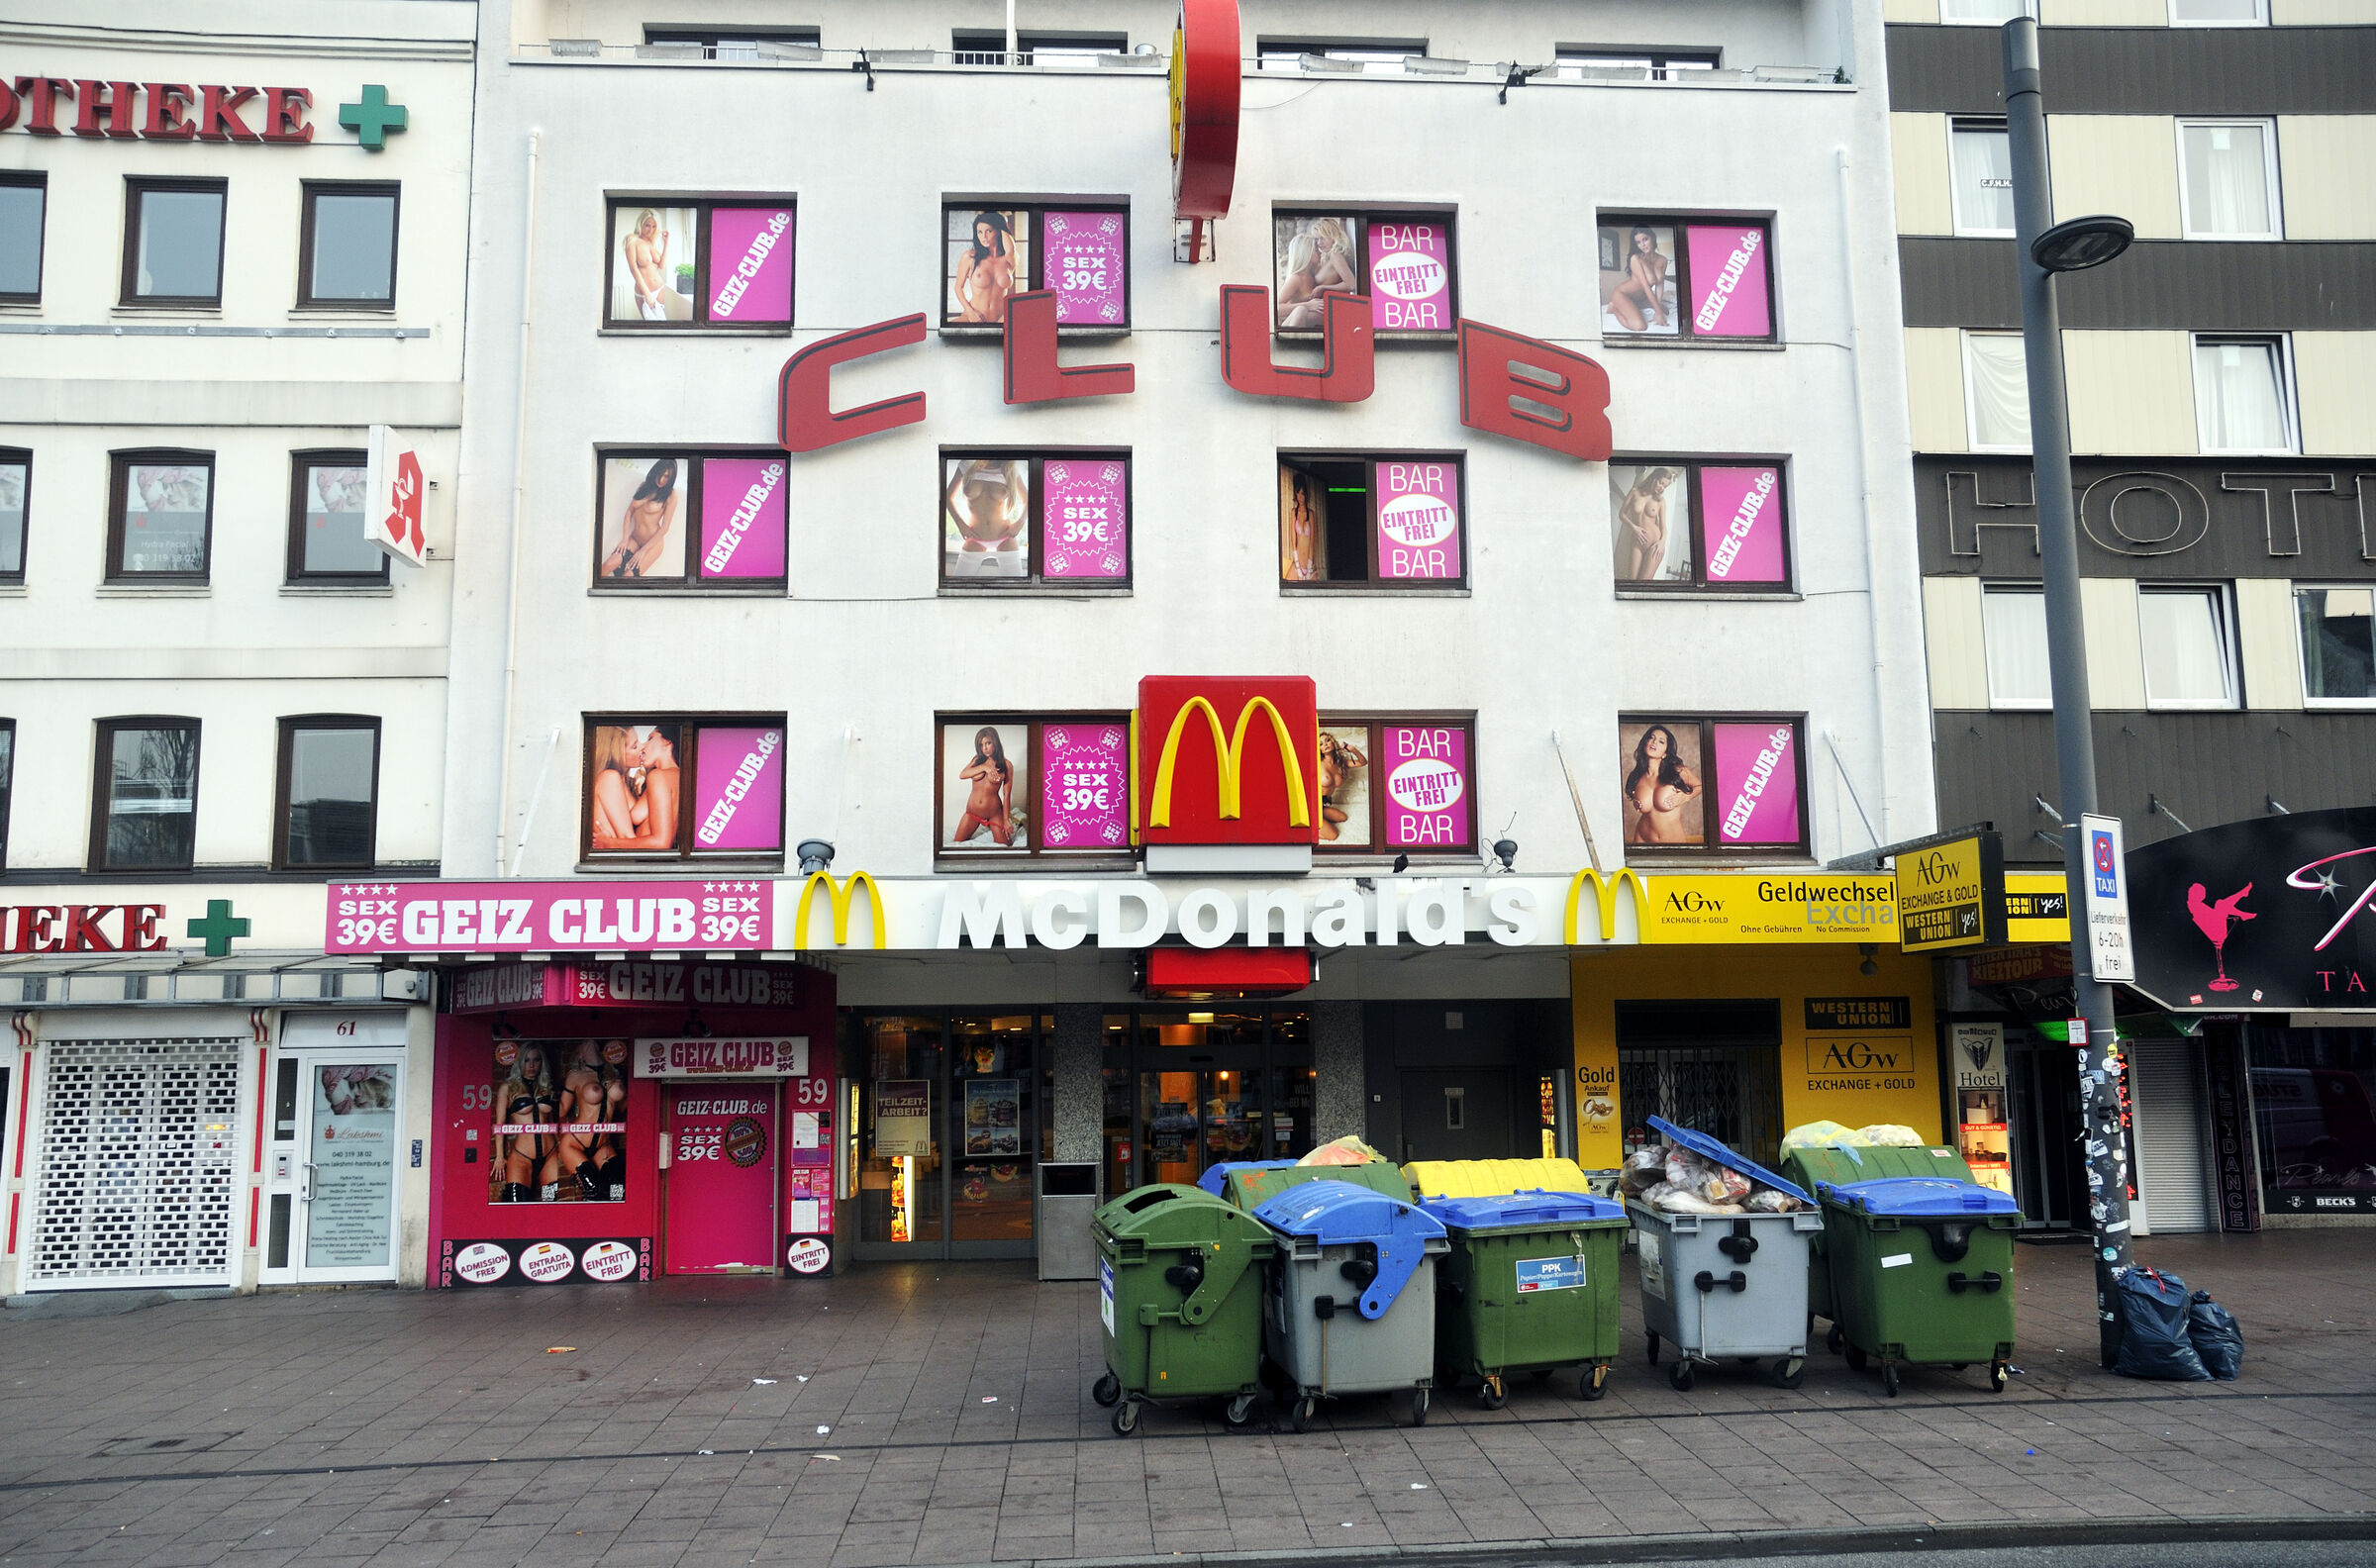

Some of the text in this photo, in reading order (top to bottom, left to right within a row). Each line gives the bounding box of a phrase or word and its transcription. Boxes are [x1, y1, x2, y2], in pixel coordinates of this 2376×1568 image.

[1381, 225, 1435, 251] BAR
[712, 211, 790, 318] GEIZ-CLUB.de
[1062, 257, 1106, 268] SEX
[1062, 270, 1107, 290] 39€
[1375, 263, 1439, 283] EINTRITT
[1695, 229, 1761, 332] GEIZ-CLUB.de
[1396, 277, 1429, 295] FREI
[1385, 302, 1438, 329] BAR
[777, 284, 1613, 462] CLUB
[1390, 465, 1443, 493] BAR
[704, 462, 784, 574] GEIZ-CLUB.de
[1063, 507, 1108, 519] SEX
[1383, 506, 1448, 529] EINTRITT
[1063, 521, 1108, 541] 39€
[1404, 522, 1436, 541] FREI
[1709, 471, 1775, 578] GEIZ-CLUB.de
[1393, 550, 1445, 577] BAR
[1398, 730, 1451, 757] BAR
[697, 732, 779, 845] GEIZ-CLUB.de
[1063, 773, 1108, 786] SEX
[1394, 771, 1459, 794] EINTRITT
[1723, 727, 1790, 839] GEIZ-CLUB.de
[1062, 788, 1109, 810] 39€
[1415, 787, 1445, 807] FREI
[1400, 816, 1453, 843] BAR
[1758, 881, 1894, 902] Geldwechsel
[2096, 877, 2116, 893] TAXI
[703, 898, 760, 913] SEX
[1902, 884, 1978, 910] EXCHANGE & GOLD
[2040, 896, 2063, 914] yes!
[339, 901, 397, 915] SEX
[937, 878, 1537, 950] McDonald's
[402, 898, 695, 945] GEIZ CLUB
[1906, 911, 1950, 929] WESTERN
[2091, 911, 2127, 925] Lieferverkehr
[337, 919, 397, 945] 39€
[701, 915, 760, 942] 39€
[1920, 924, 1951, 940] UNION
[2099, 931, 2124, 948] 6-20h
[2105, 955, 2122, 970] frei
[579, 971, 606, 980] SEX
[610, 962, 770, 1005] GEIZ CLUB
[466, 963, 533, 1007] GEIZ CLUB
[578, 982, 606, 999] 39€
[773, 991, 794, 1005] 39€
[1812, 1002, 1890, 1013] WESTERN
[337, 1021, 356, 1036] 61
[1837, 1014, 1890, 1025] UNION
[670, 1042, 717, 1067] GEIZ
[722, 1041, 774, 1066] CLUB
[648, 1064, 666, 1074] 39€
[777, 1062, 794, 1072] 39€
[1578, 1066, 1615, 1083] Gold
[1808, 1079, 1871, 1090] EXCHANGE
[1884, 1078, 1915, 1089] GOLD
[1960, 1072, 2000, 1086] Hotel
[462, 1085, 492, 1110] 59
[798, 1079, 828, 1104] 59
[677, 1100, 767, 1116] GEIZ-CLUB.de
[878, 1097, 927, 1107] TEILZEIT-
[881, 1108, 927, 1117] ARBEIT?
[338, 1127, 383, 1139] Lakshmi
[680, 1135, 722, 1144] SEX
[677, 1145, 721, 1160] 39€
[2316, 1196, 2357, 1207] BECK'S
[529, 1253, 567, 1269] ENTRADA
[586, 1250, 631, 1271] EINTRITT
[640, 1238, 650, 1281] BAR
[791, 1246, 827, 1262] EINTRITT
[803, 1257, 821, 1269] FREI
[442, 1240, 452, 1287] BAR
[460, 1254, 508, 1274] ADMISSION
[476, 1266, 497, 1278] FREE
[531, 1261, 572, 1278] GRATUITA
[601, 1264, 624, 1278] FREI
[1541, 1263, 1561, 1273] PPK
